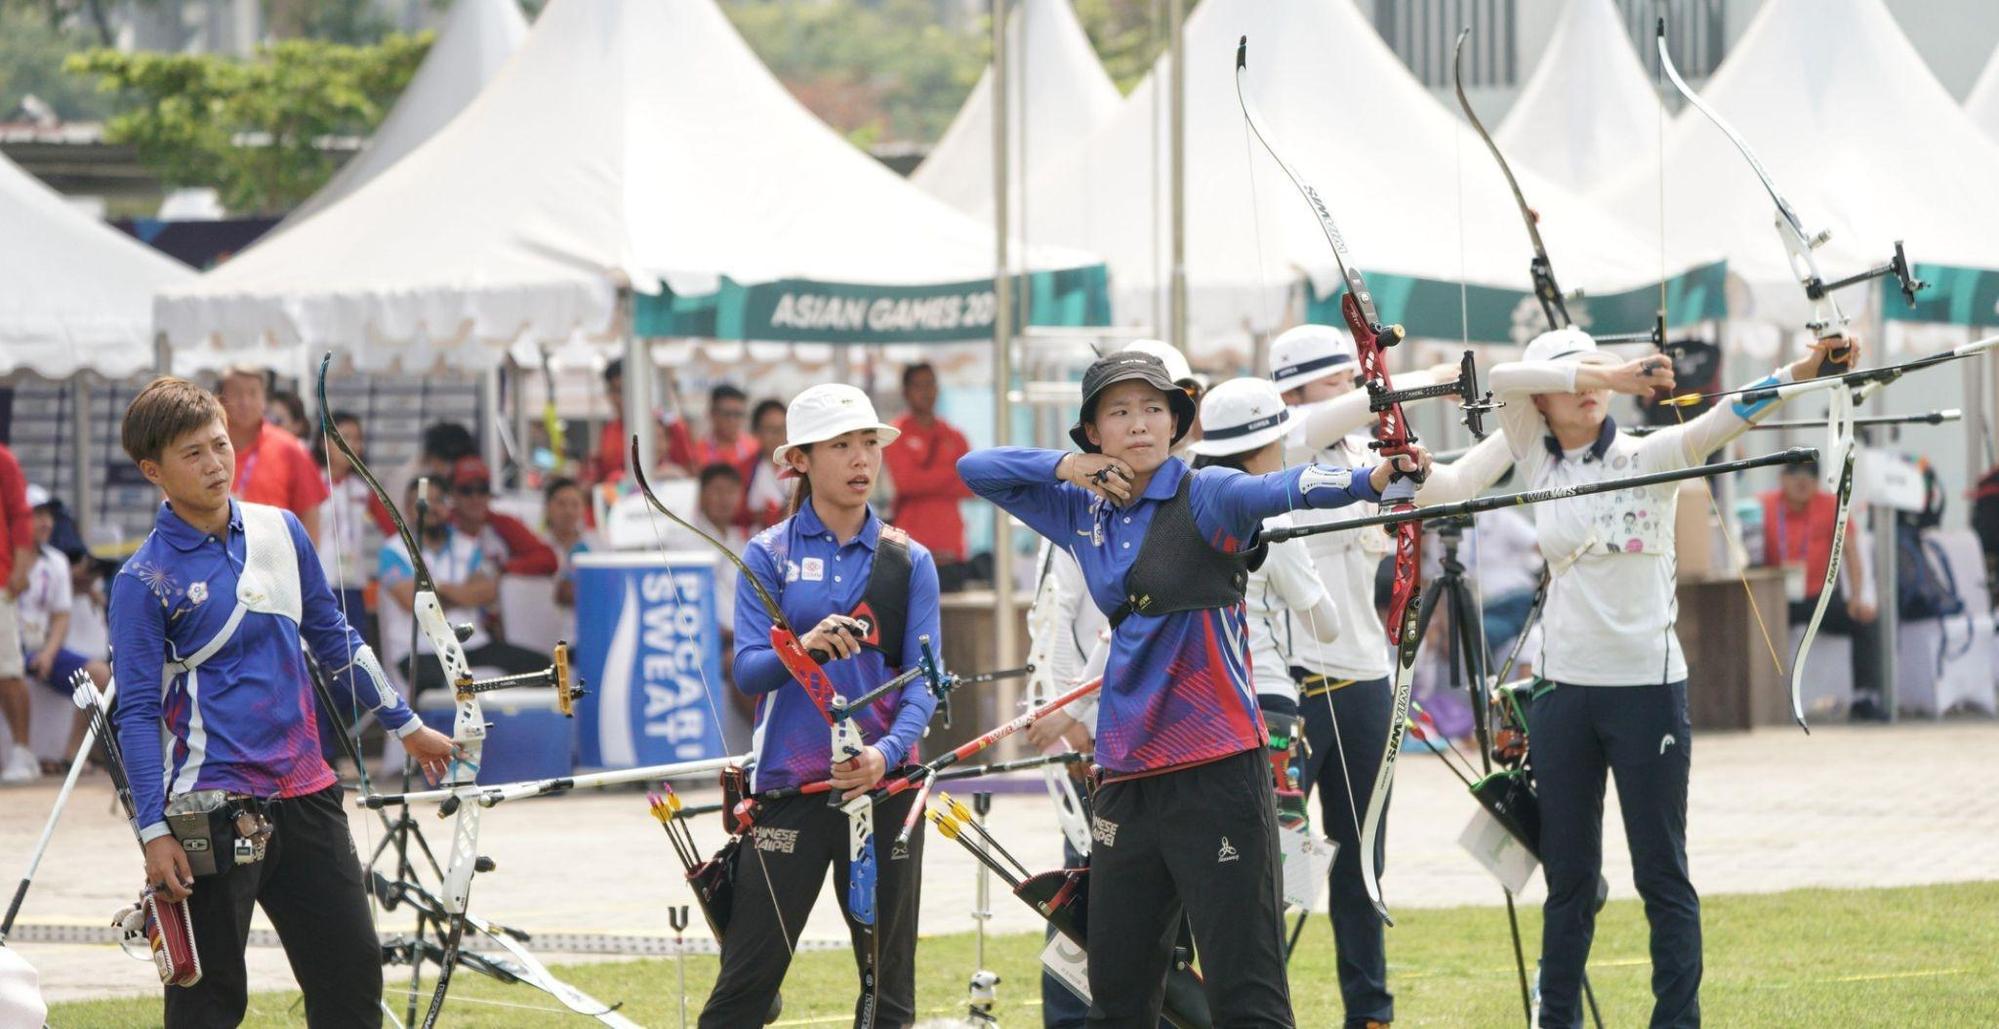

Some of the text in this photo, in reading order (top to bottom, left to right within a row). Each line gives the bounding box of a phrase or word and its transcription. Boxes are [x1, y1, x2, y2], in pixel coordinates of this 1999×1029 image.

[770, 292, 867, 331] ASIAN
[867, 294, 963, 332] GAMES
[641, 572, 680, 745] SWEAT
[672, 572, 705, 760] POCARI
[1386, 684, 1410, 764] WIAWIS
[753, 826, 800, 842] HINESE
